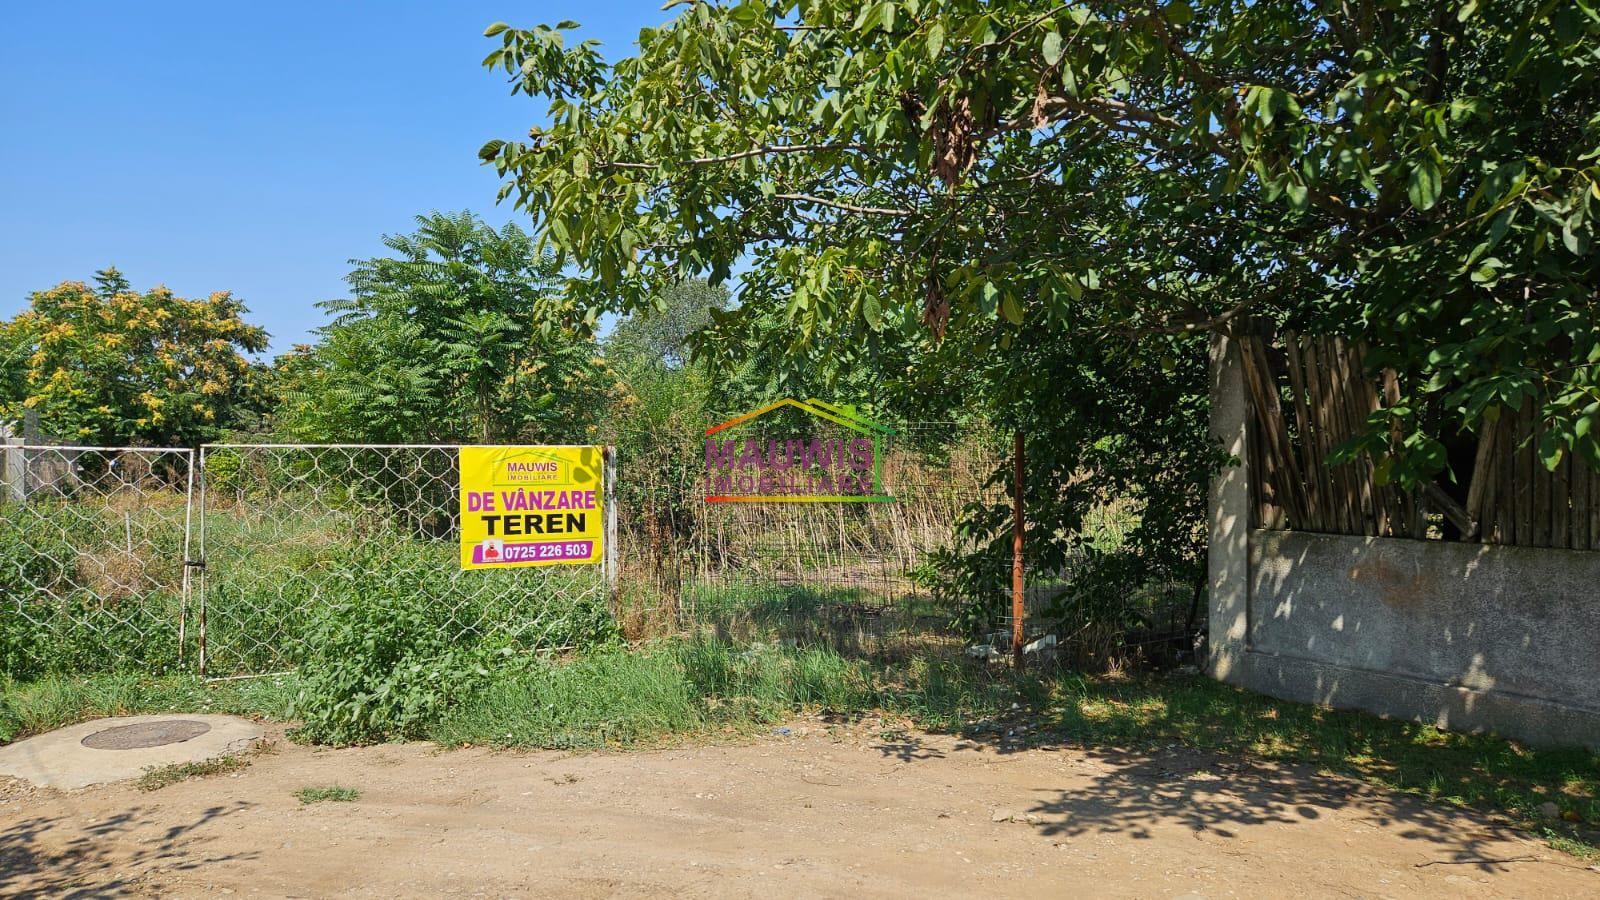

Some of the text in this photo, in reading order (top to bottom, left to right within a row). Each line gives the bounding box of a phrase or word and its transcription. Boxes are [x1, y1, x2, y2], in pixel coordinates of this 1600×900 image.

[507, 462, 558, 472] MAUWIS
[467, 487, 597, 513] DE VÂNZARE
[481, 512, 586, 536] TEREN
[504, 543, 588, 559] 0725 226 503
